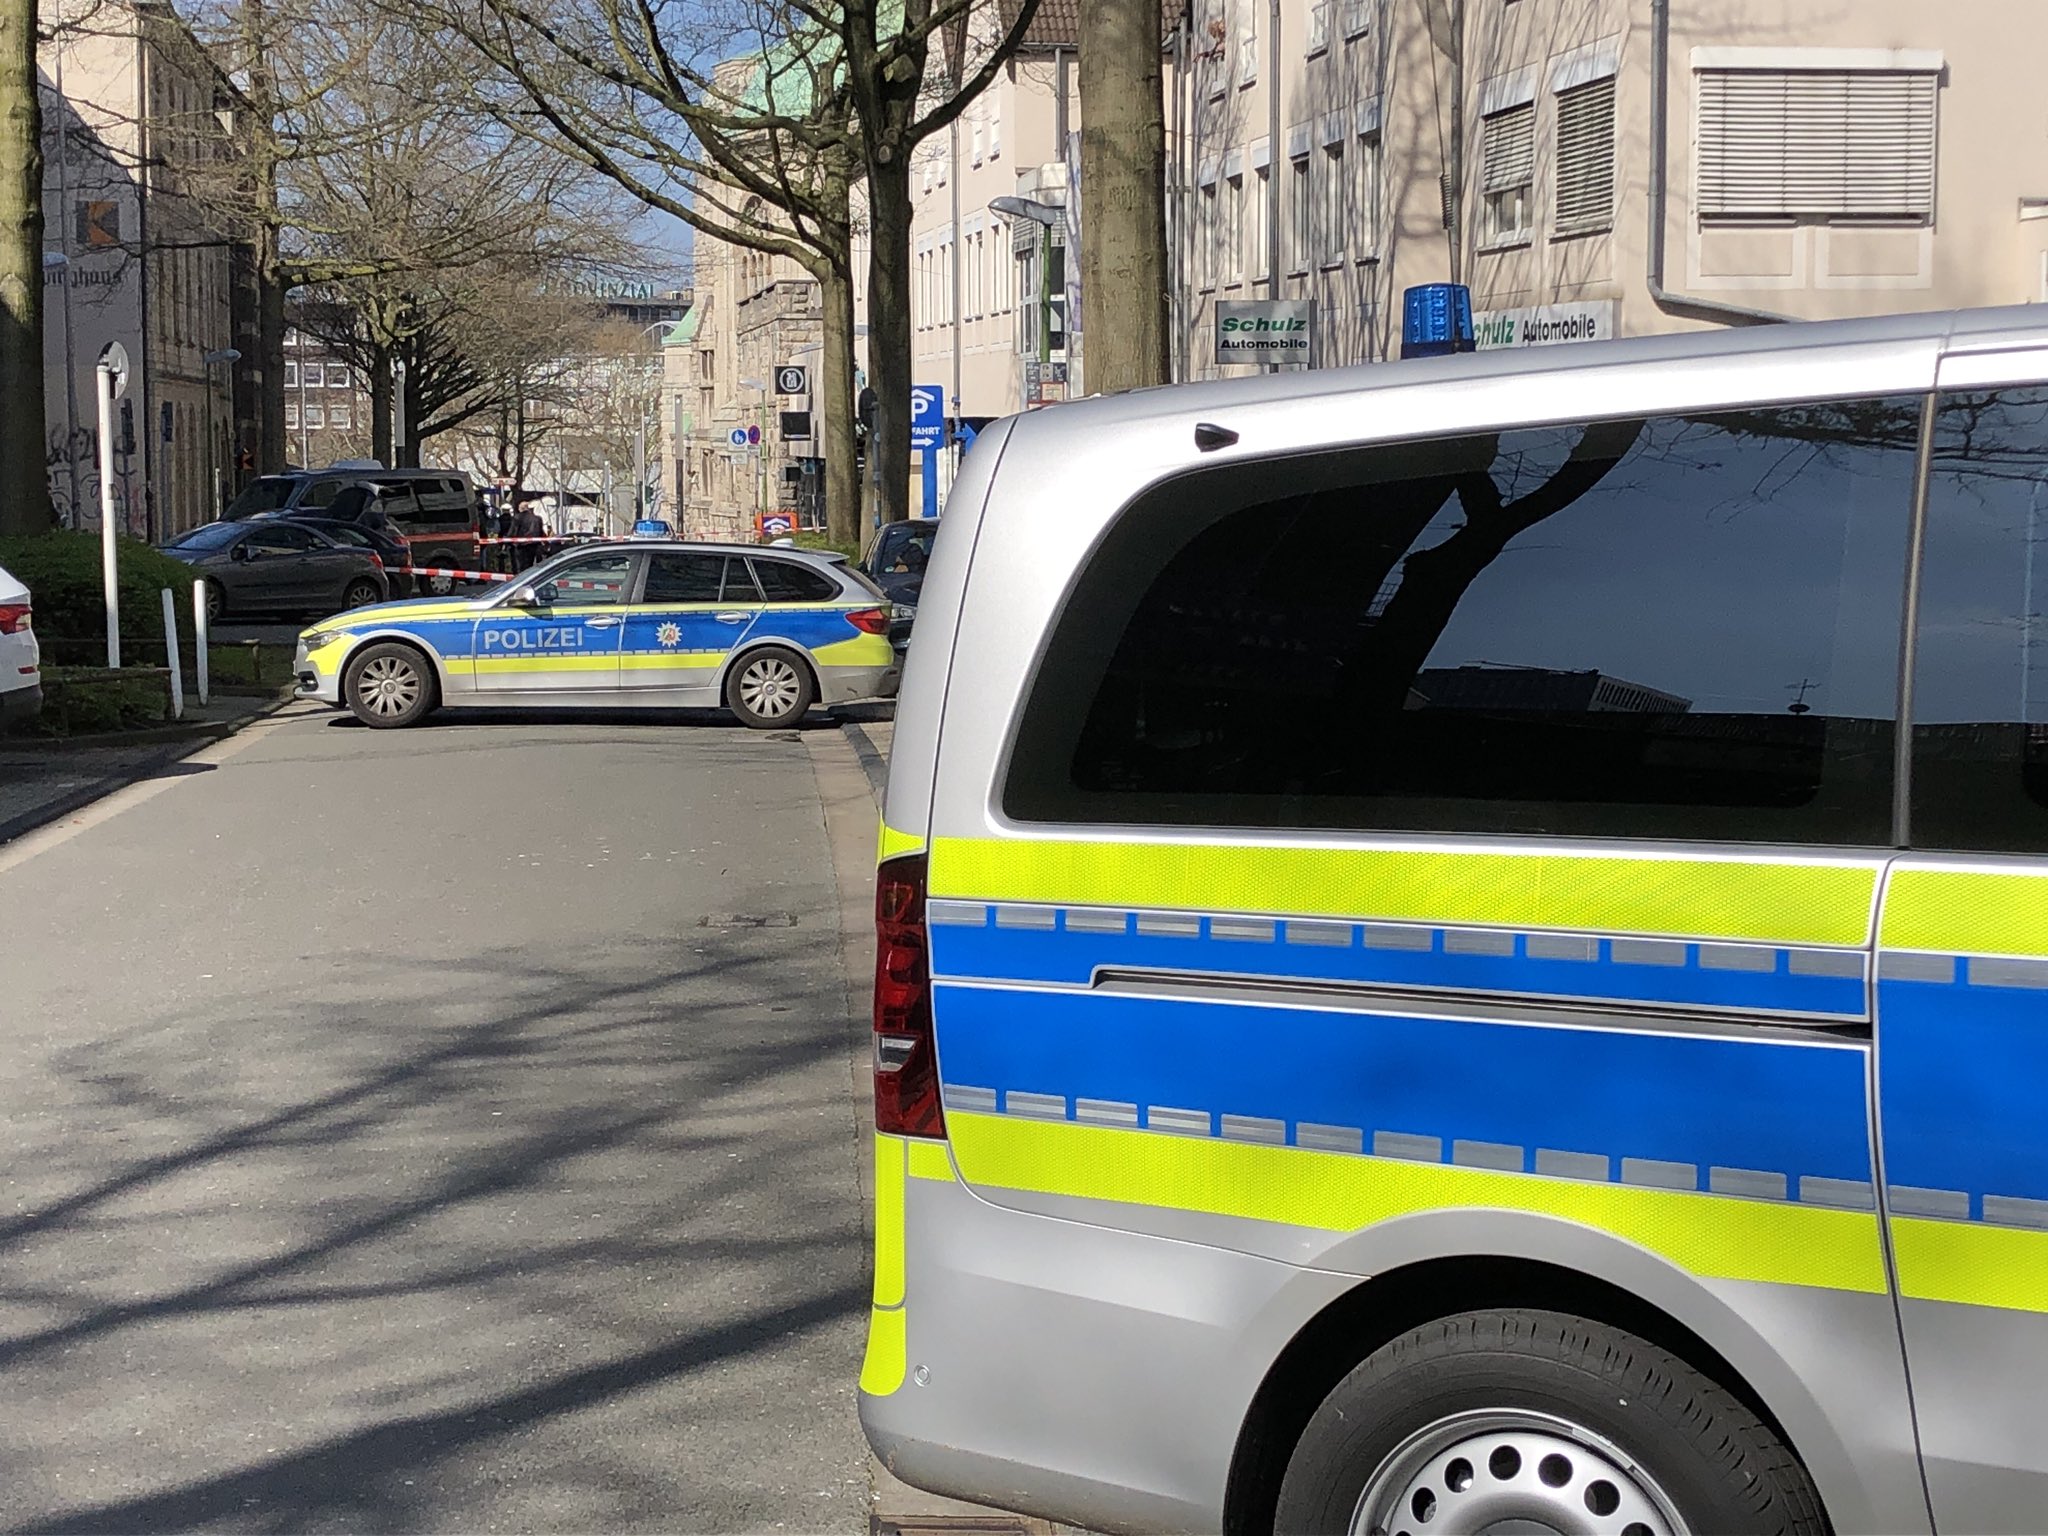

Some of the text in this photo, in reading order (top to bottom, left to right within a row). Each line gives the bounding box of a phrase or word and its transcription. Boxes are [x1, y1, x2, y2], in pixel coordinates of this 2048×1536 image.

[1221, 317, 1307, 332] Schulz
[1473, 313, 1596, 346] chulz Automobile
[1220, 339, 1308, 349] Automobile
[911, 398, 928, 422] P
[911, 426, 940, 435] FAHRT
[484, 627, 583, 650] POLIZEI
